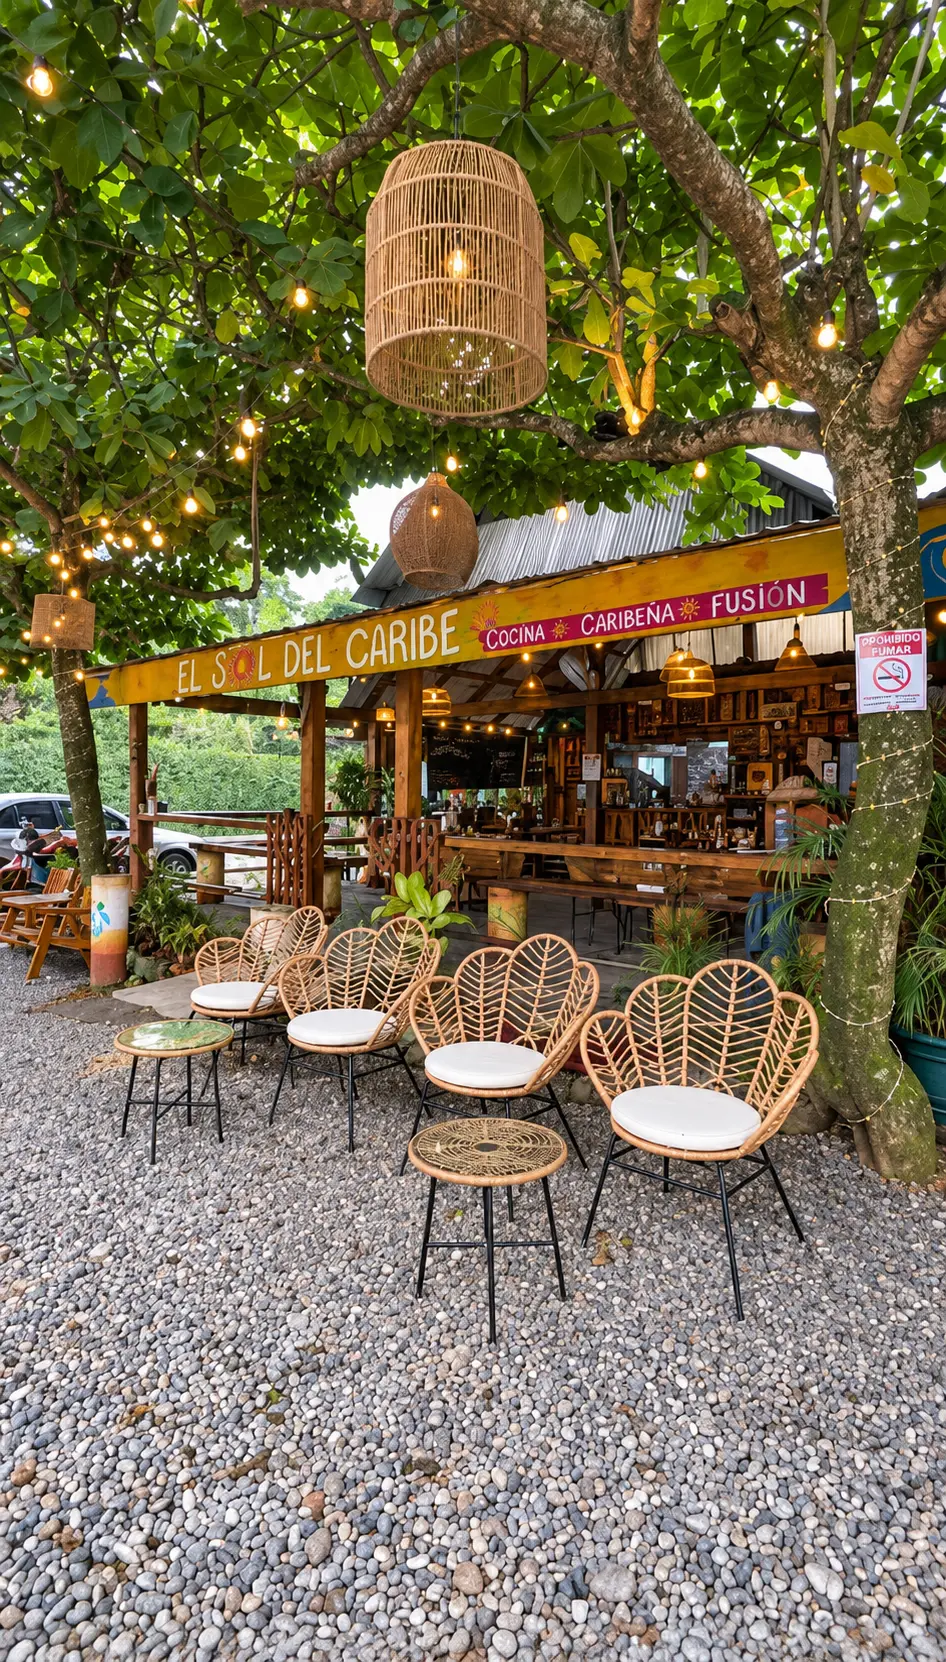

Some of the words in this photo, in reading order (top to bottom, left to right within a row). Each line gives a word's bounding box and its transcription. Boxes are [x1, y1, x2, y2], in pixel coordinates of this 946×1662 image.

[486, 623, 545, 650] COCINA
[581, 600, 675, 636] CARIBEÑA
[711, 580, 805, 618] FUSIÓN
[178, 659, 201, 694] EL
[212, 645, 271, 690] SOL
[284, 634, 331, 678] DEL
[346, 608, 460, 669] CARIBE
[872, 645, 912, 656] FUMAR
